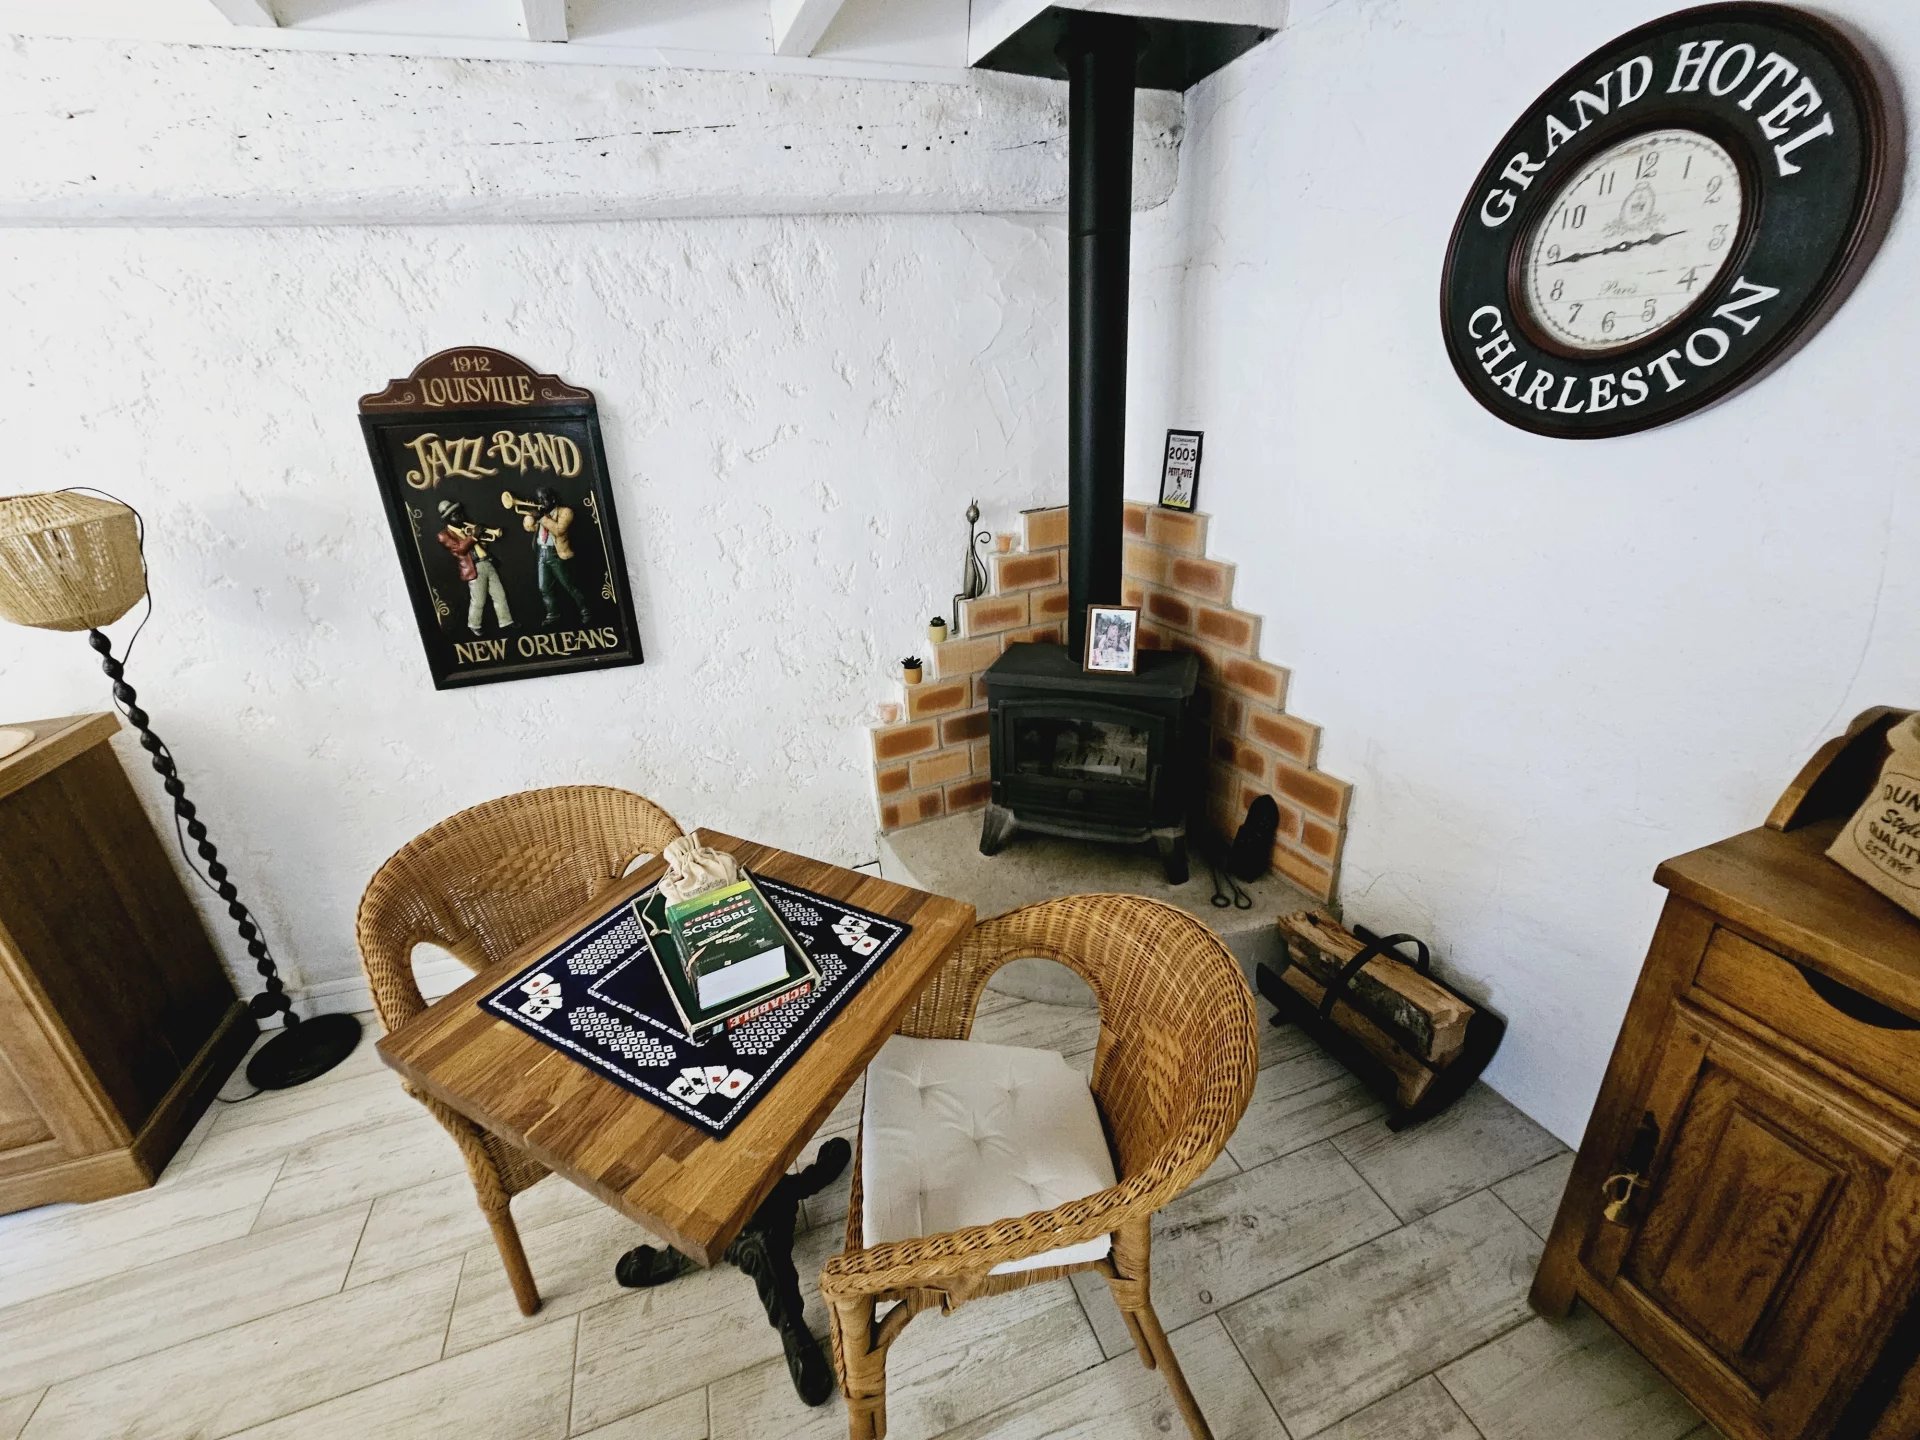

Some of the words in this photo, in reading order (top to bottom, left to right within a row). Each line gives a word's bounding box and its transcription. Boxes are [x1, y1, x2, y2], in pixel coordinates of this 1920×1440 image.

[1480, 55, 1654, 228] GRAND
[1666, 39, 1834, 177] HOTEL
[1635, 151, 1659, 179] 12
[1598, 171, 1616, 196] 11
[1704, 175, 1723, 204] 2
[1562, 204, 1587, 230] 10
[1708, 223, 1729, 251] 3
[1550, 279, 1564, 302] 8
[1675, 266, 1699, 293] 4
[1568, 302, 1583, 324] 7
[1601, 311, 1617, 334] 6
[1641, 298, 1658, 323] 5
[1468, 275, 1780, 415] CHARLESTON
[451, 356, 492, 373] 1912
[418, 375, 535, 407] LOUISVILLE
[403, 432, 498, 490] JAZZ
[487, 430, 583, 479] BAND
[1169, 446, 1196, 462] 2003
[454, 637, 508, 664] NEW
[517, 627, 619, 656] ORLEANS
[681, 904, 758, 938] SCRABBLE
[728, 983, 811, 1029] SCRABBLE
